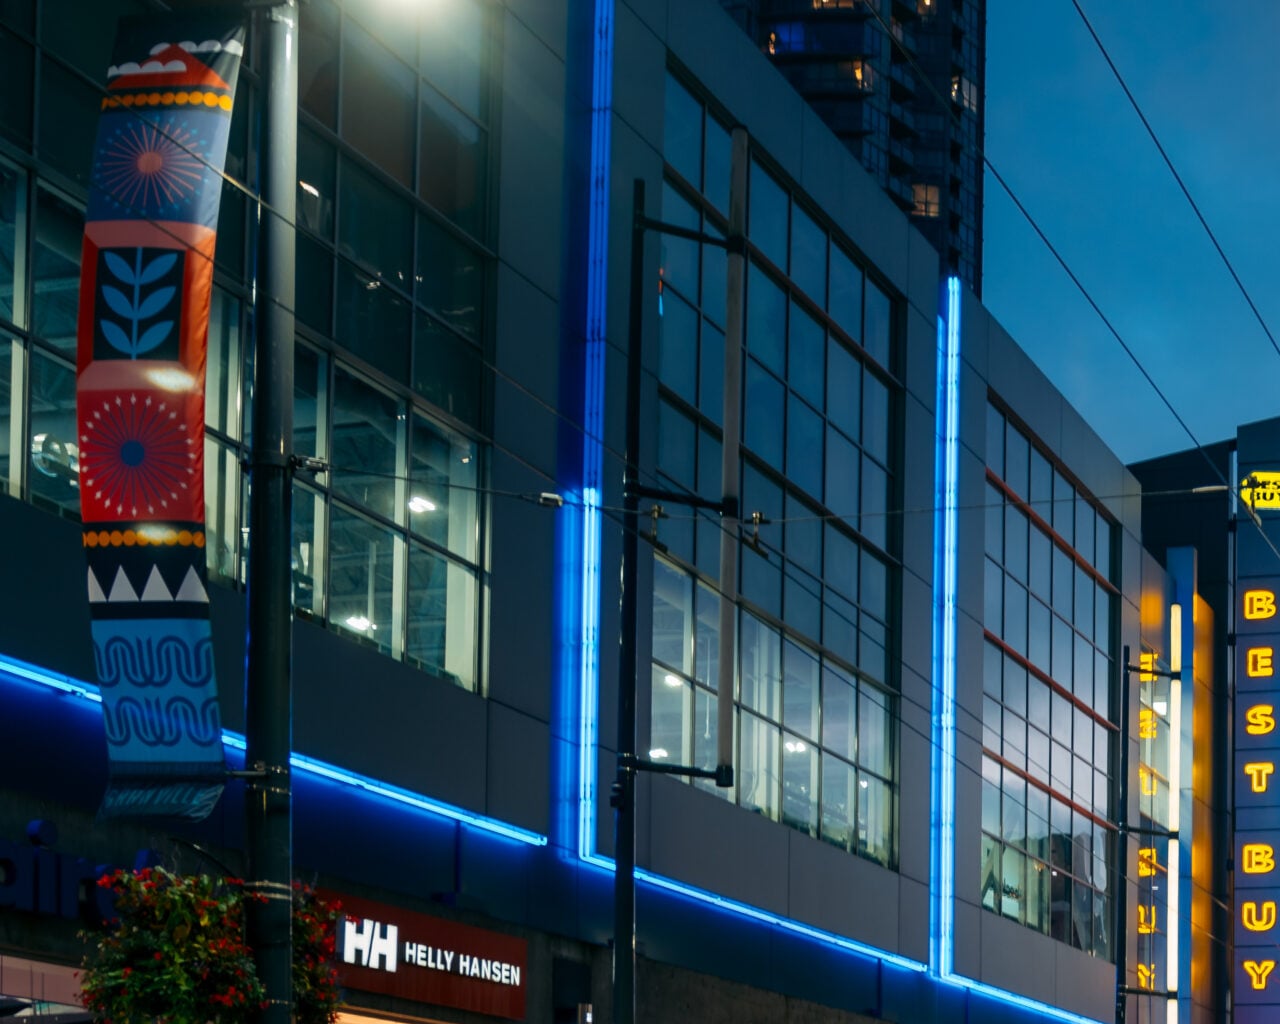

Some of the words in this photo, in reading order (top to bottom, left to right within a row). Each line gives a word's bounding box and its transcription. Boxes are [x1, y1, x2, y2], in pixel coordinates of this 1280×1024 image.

[1244, 589, 1277, 794] BEST
[405, 941, 454, 972] HELLY
[459, 953, 521, 986] HANSEN
[1242, 843, 1277, 990] BUY
